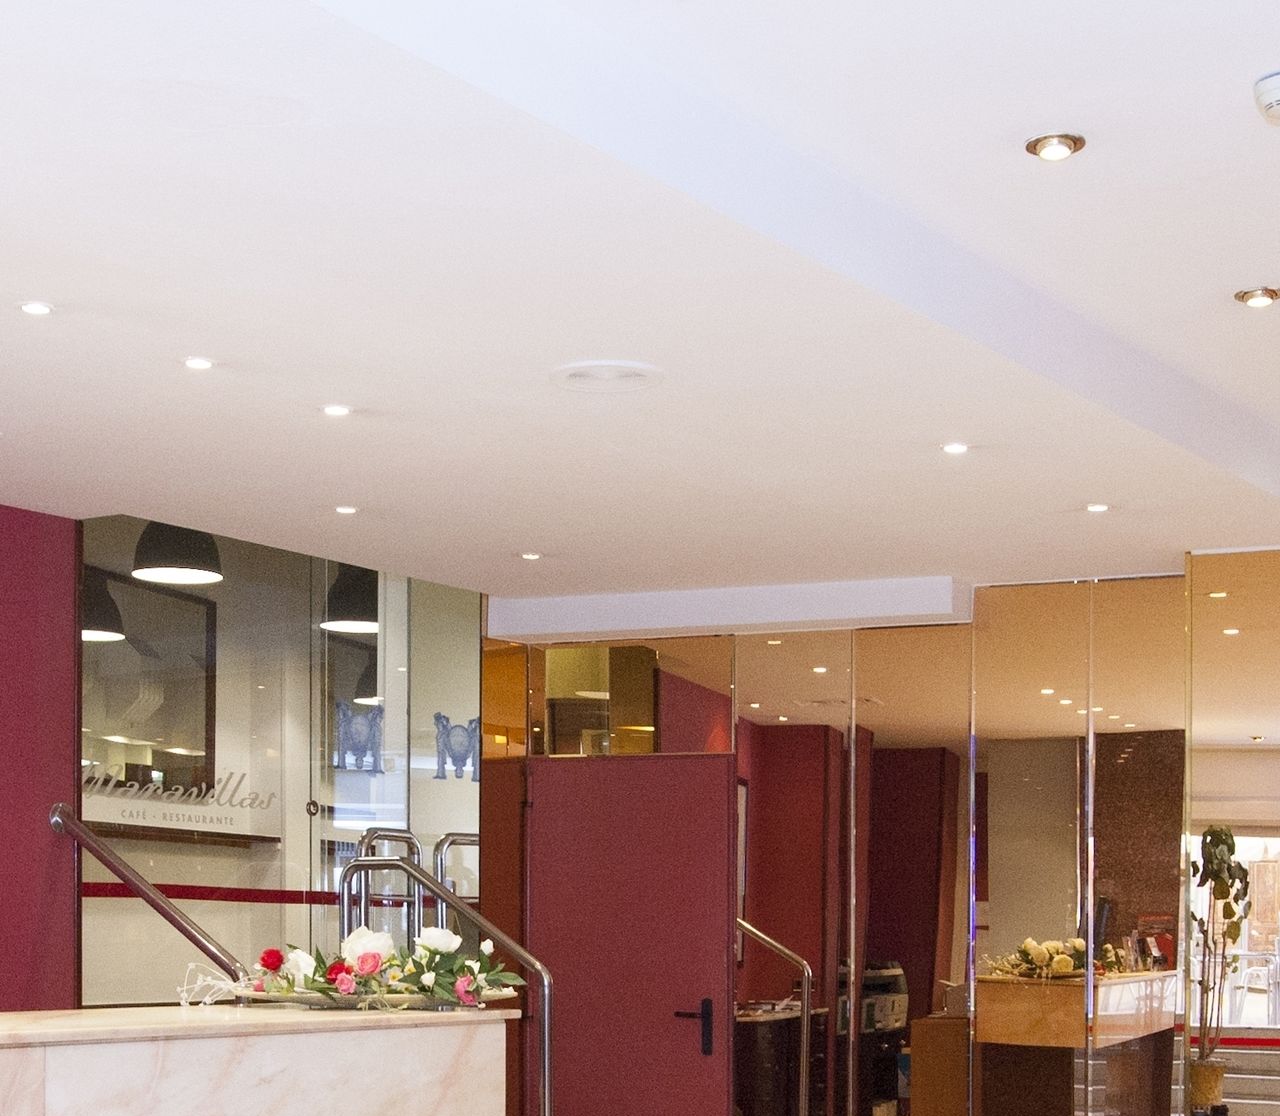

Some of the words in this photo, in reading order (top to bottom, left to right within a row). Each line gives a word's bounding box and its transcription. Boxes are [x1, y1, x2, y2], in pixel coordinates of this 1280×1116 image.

[83, 764, 277, 810] Maravillas
[121, 808, 147, 821] CAFÉ
[162, 813, 234, 826] RESTAURANTE
